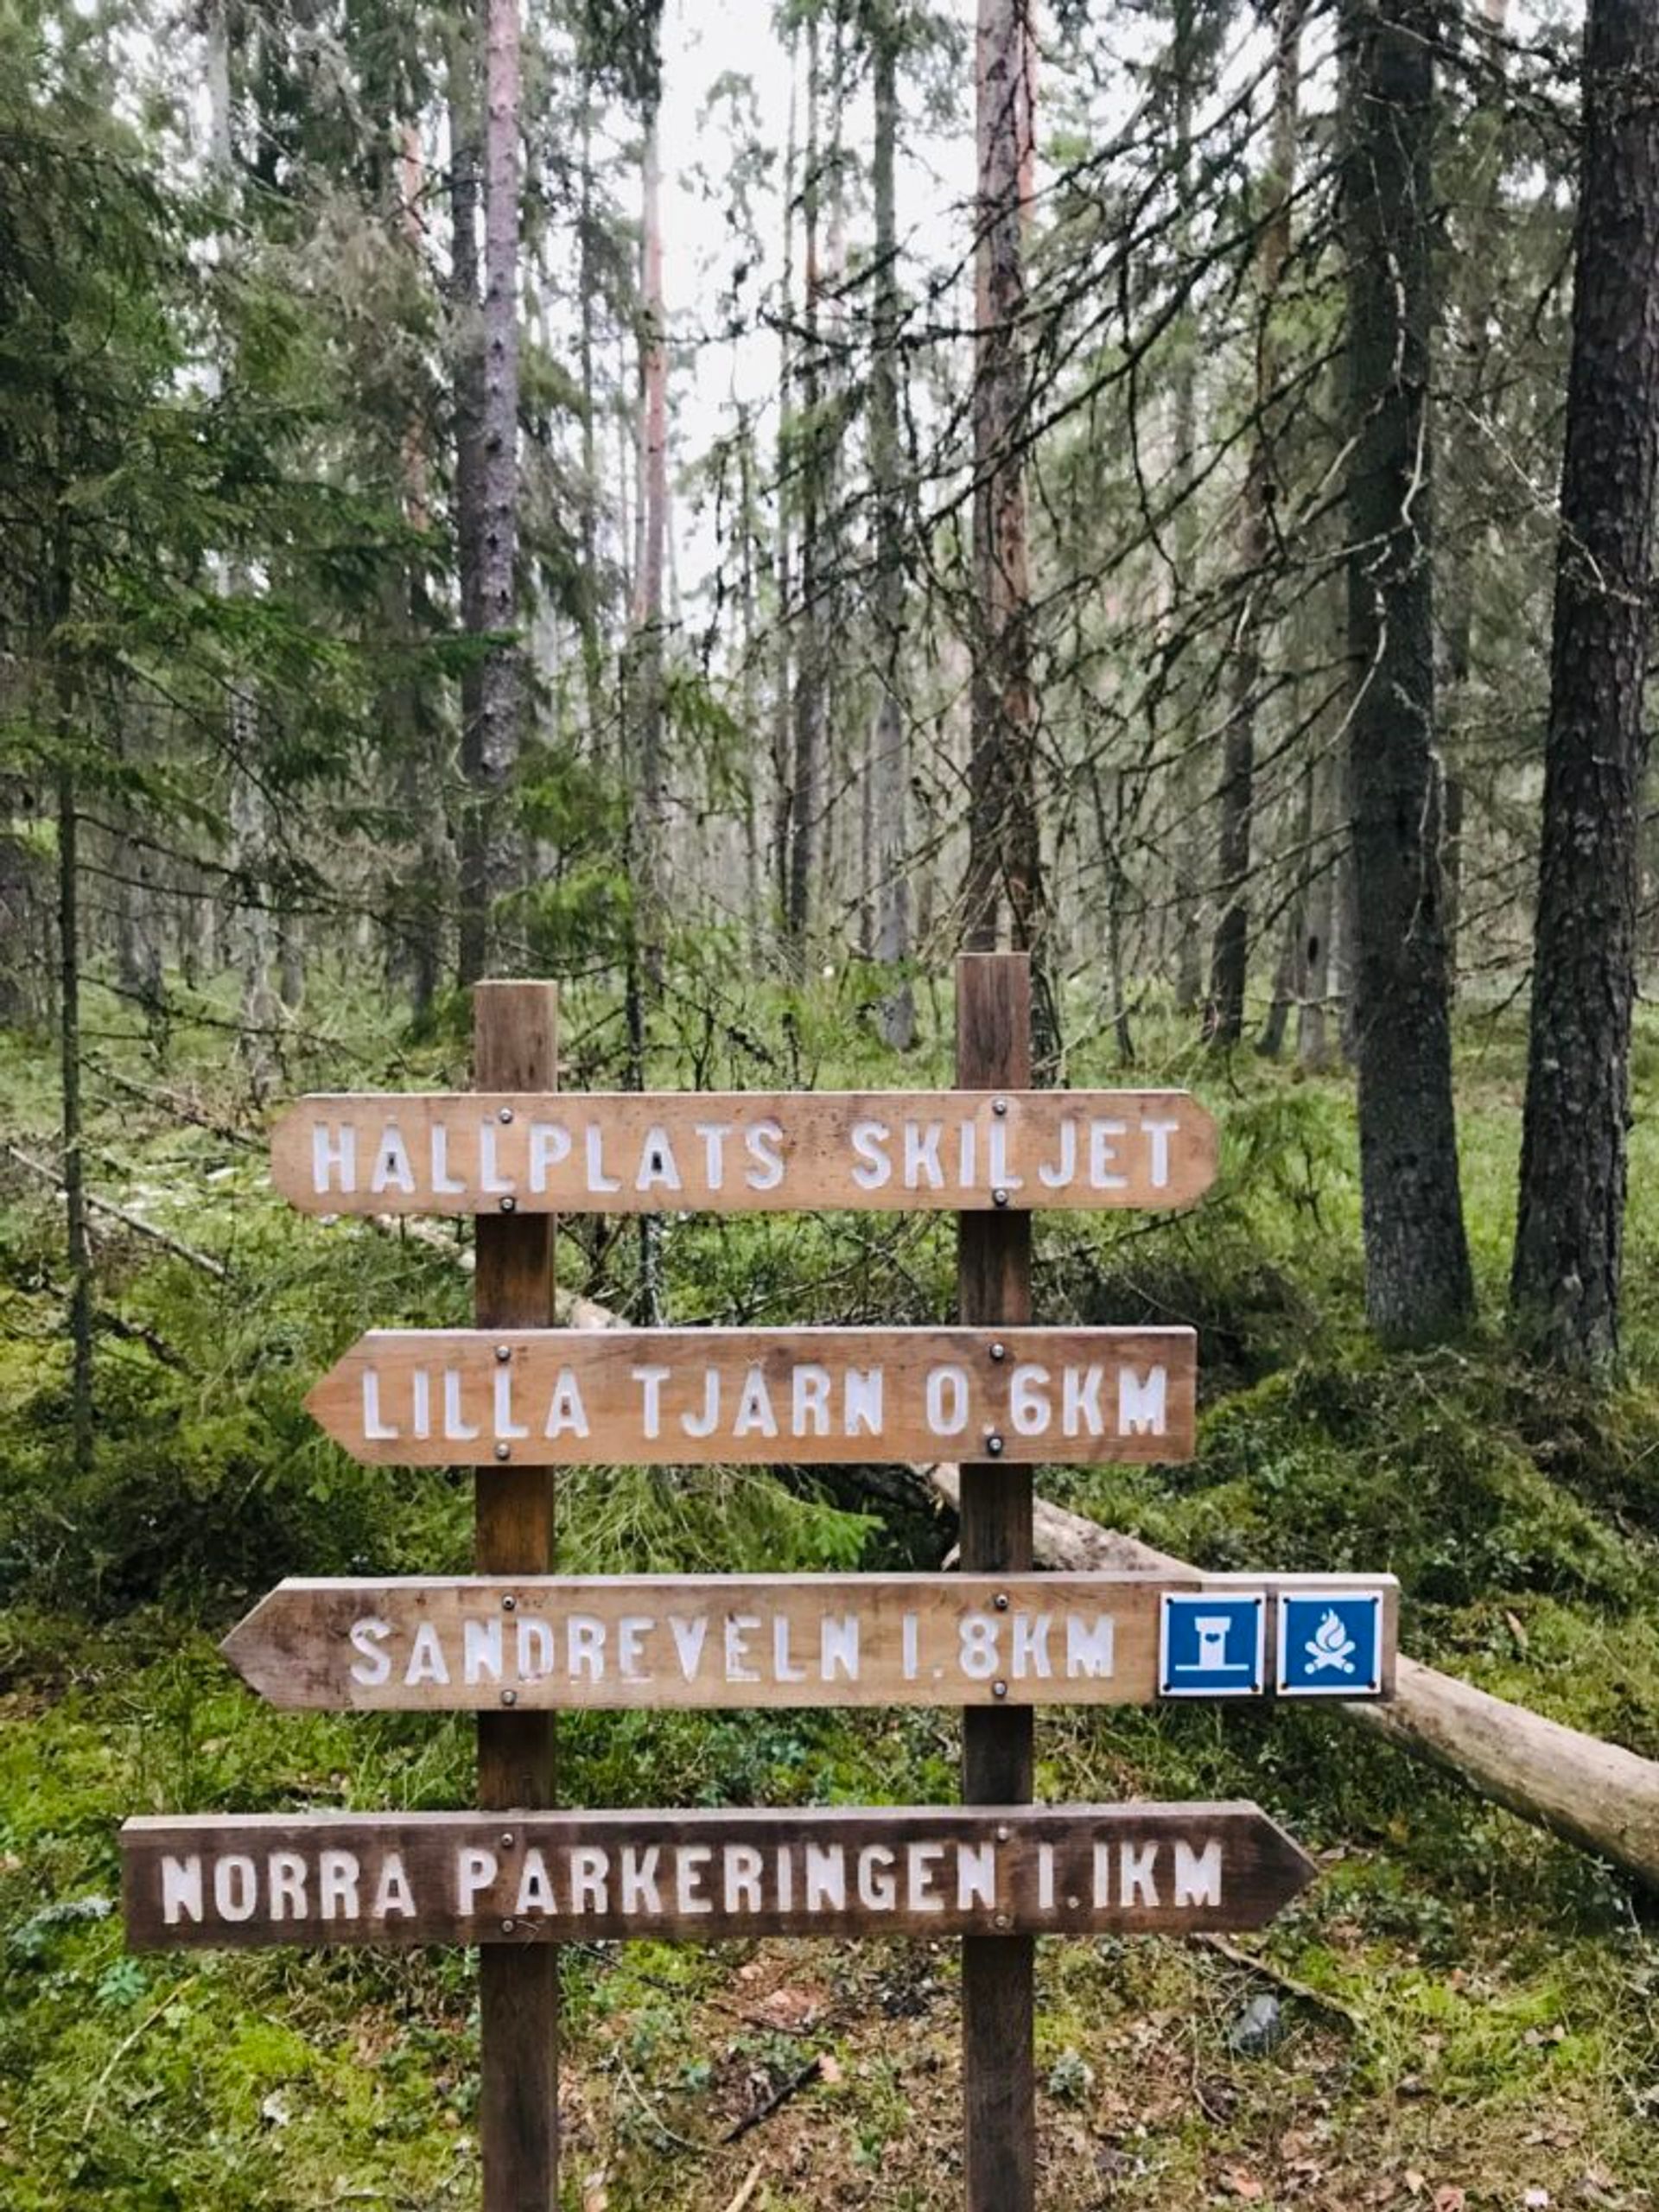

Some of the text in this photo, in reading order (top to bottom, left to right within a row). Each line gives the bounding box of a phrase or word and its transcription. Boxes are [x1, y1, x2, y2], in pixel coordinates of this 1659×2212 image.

[850, 1118, 1180, 1191] SKILJET
[362, 1363, 591, 1440] LILLA
[925, 1362, 1167, 1438] 0.6KM
[349, 1611, 1116, 1688] SANDREVELN 1.8KM
[161, 1839, 1224, 1925] NORRA PARKERINGEN 1.1KM
